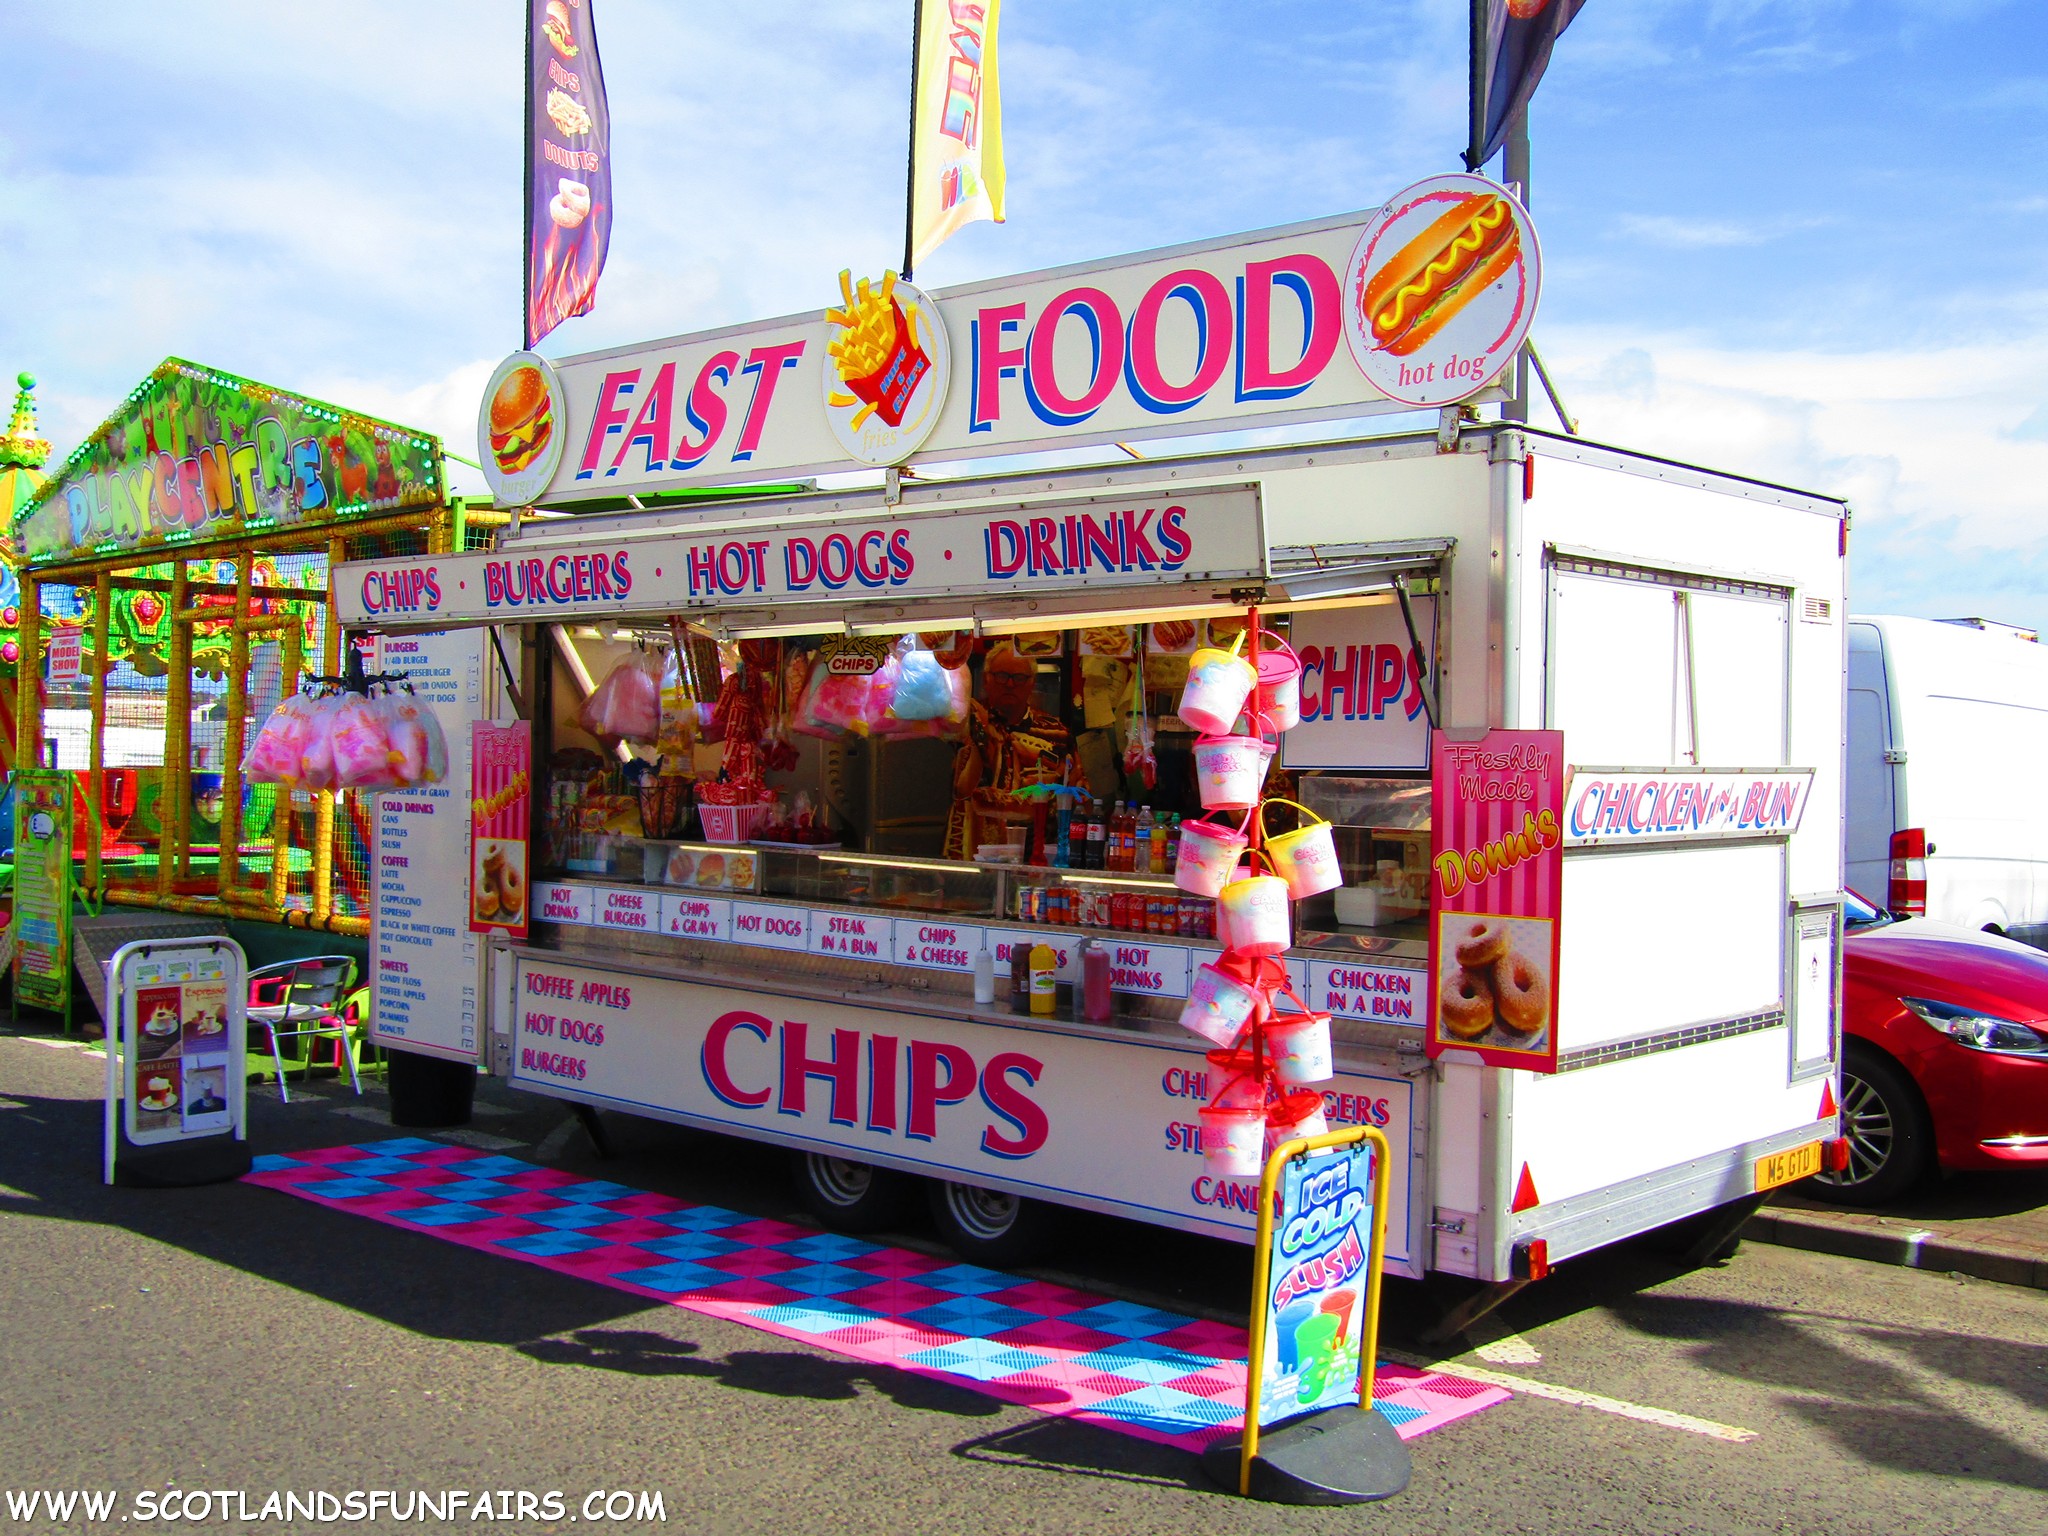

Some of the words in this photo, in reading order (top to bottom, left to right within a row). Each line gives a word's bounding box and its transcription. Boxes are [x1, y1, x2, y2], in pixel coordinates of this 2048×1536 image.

[548, 58, 581, 93] CHIPS
[543, 139, 599, 173] DONUTS
[576, 339, 806, 480] FAST
[969, 253, 1341, 434] FOOD
[1398, 361, 1434, 388] hot
[1442, 354, 1487, 381] dog
[862, 428, 897, 456] fries
[361, 566, 442, 615] CHIPS
[484, 551, 633, 607] BURGERS
[686, 541, 770, 597] HOT
[783, 528, 915, 591] DOGS
[984, 505, 1192, 579] DRINKS
[52, 646, 80, 658] MODEL
[384, 641, 419, 653] BURGERS
[52, 659, 79, 670] SHOW
[403, 655, 428, 664] BURGER
[832, 657, 875, 672] CHIPS
[431, 680, 458, 690] ONIONS
[1300, 643, 1428, 722] CHIPS
[437, 694, 456, 703] DOGS
[1443, 743, 1550, 782] Freshly
[429, 788, 450, 798] GRAVY
[1459, 774, 1533, 802] Made
[382, 801, 403, 812] COLD
[405, 802, 434, 814] DRINKS
[472, 768, 530, 829] Donuts
[1570, 780, 1714, 837] CHICKEN
[1737, 781, 1801, 829] BUN
[381, 814, 399, 824] CANS
[381, 827, 408, 837] BOTTLES
[381, 839, 401, 849] SLUSH
[1435, 808, 1560, 898] Donuts
[381, 855, 409, 868] COFFEE
[381, 869, 399, 879] LATTE
[381, 882, 405, 892] MOCHA
[550, 888, 572, 903] HOT
[380, 894, 422, 907] CAPPUCCINO
[607, 893, 643, 910] CHEESE
[679, 900, 710, 918] CHIPS
[380, 907, 412, 918] ESPRESSO
[543, 904, 579, 920] DRINKS
[603, 910, 647, 928] BURGERS
[380, 919, 401, 929] BLACK
[410, 923, 431, 934] WHITE
[432, 926, 456, 937] COFFEE
[671, 918, 681, 932] &
[683, 918, 719, 936] GRAVY
[736, 914, 762, 932] HOT
[766, 917, 802, 937] DOGS
[828, 917, 866, 935] STEAK
[380, 932, 394, 941] HOT
[395, 934, 433, 946] CHOCOLATE
[919, 926, 957, 946] CHIPS
[380, 944, 392, 954] TEA
[821, 935, 836, 950] IN
[839, 937, 848, 951] A
[851, 939, 878, 956] BUN
[906, 946, 917, 960] &
[921, 947, 969, 967] CHEESE
[996, 943, 1068, 967] BURS
[1116, 947, 1150, 966] HOT
[379, 959, 409, 973] SWEETS
[379, 973, 401, 984] CANDY
[402, 976, 422, 987] FLOSS
[1109, 967, 1163, 990] DRINKS
[1328, 968, 1411, 995] CHICKEN
[184, 986, 228, 1001] Espresso
[379, 986, 401, 996] TOFFEE
[403, 990, 426, 1001] APPLES
[525, 972, 575, 1000] TOFFEE
[579, 981, 631, 1010] APPLES
[379, 998, 410, 1011] POPCORN
[1327, 991, 1347, 1011] IN
[1352, 995, 1367, 1014] A
[1373, 996, 1412, 1018] BUN
[379, 1011, 409, 1024] DUMMIES
[378, 1023, 406, 1036] DONUTS
[525, 1011, 556, 1037] HOT
[560, 1018, 605, 1046] DOGS
[157, 1061, 180, 1071] LATTE
[521, 1048, 587, 1081] BURGERS
[700, 1010, 1049, 1161] CHIPS
[1301, 1160, 1349, 1213] ICE
[1282, 1191, 1363, 1253] COLD
[1274, 1225, 1364, 1312] SLUSH
